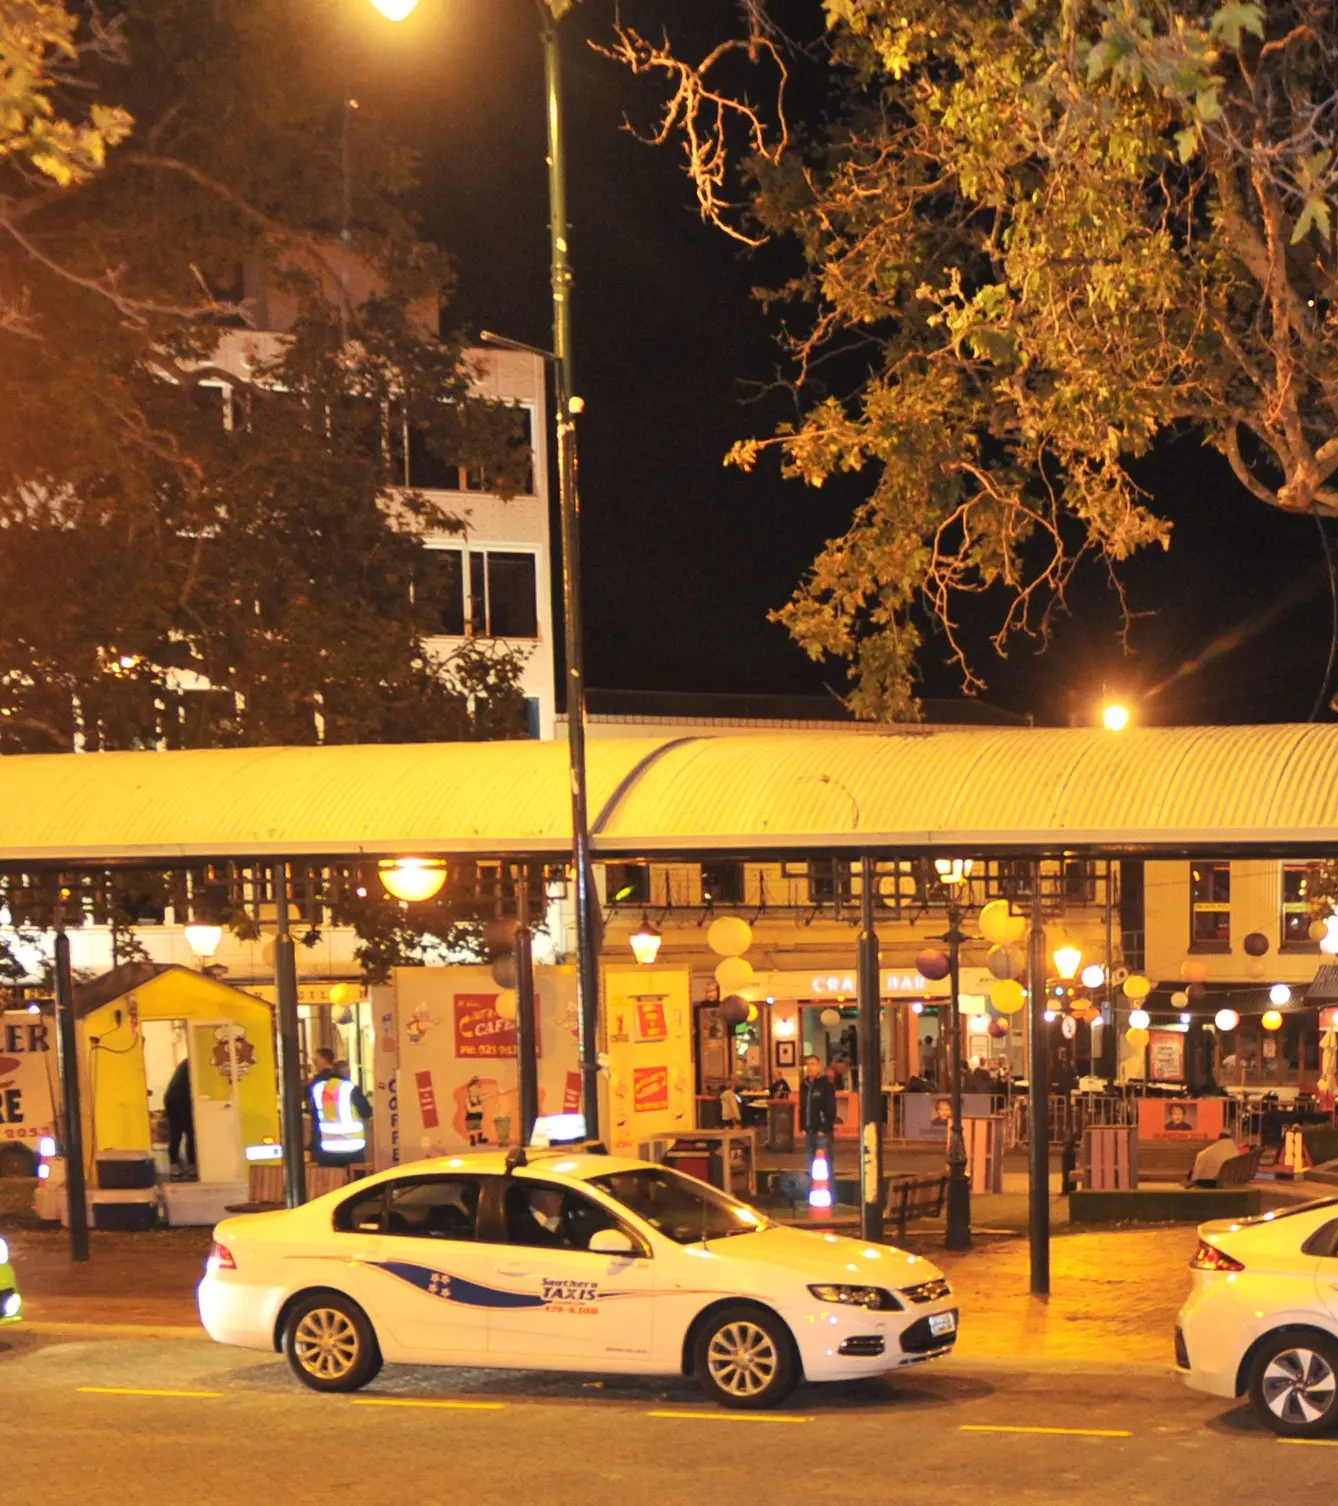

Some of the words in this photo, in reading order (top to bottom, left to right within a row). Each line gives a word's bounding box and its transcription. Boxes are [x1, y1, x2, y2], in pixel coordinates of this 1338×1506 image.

[811, 975, 854, 993] CRA
[0, 1024, 50, 1053] ER
[388, 1079, 400, 1163] COFFE
[543, 1287, 597, 1301] TAXIS
